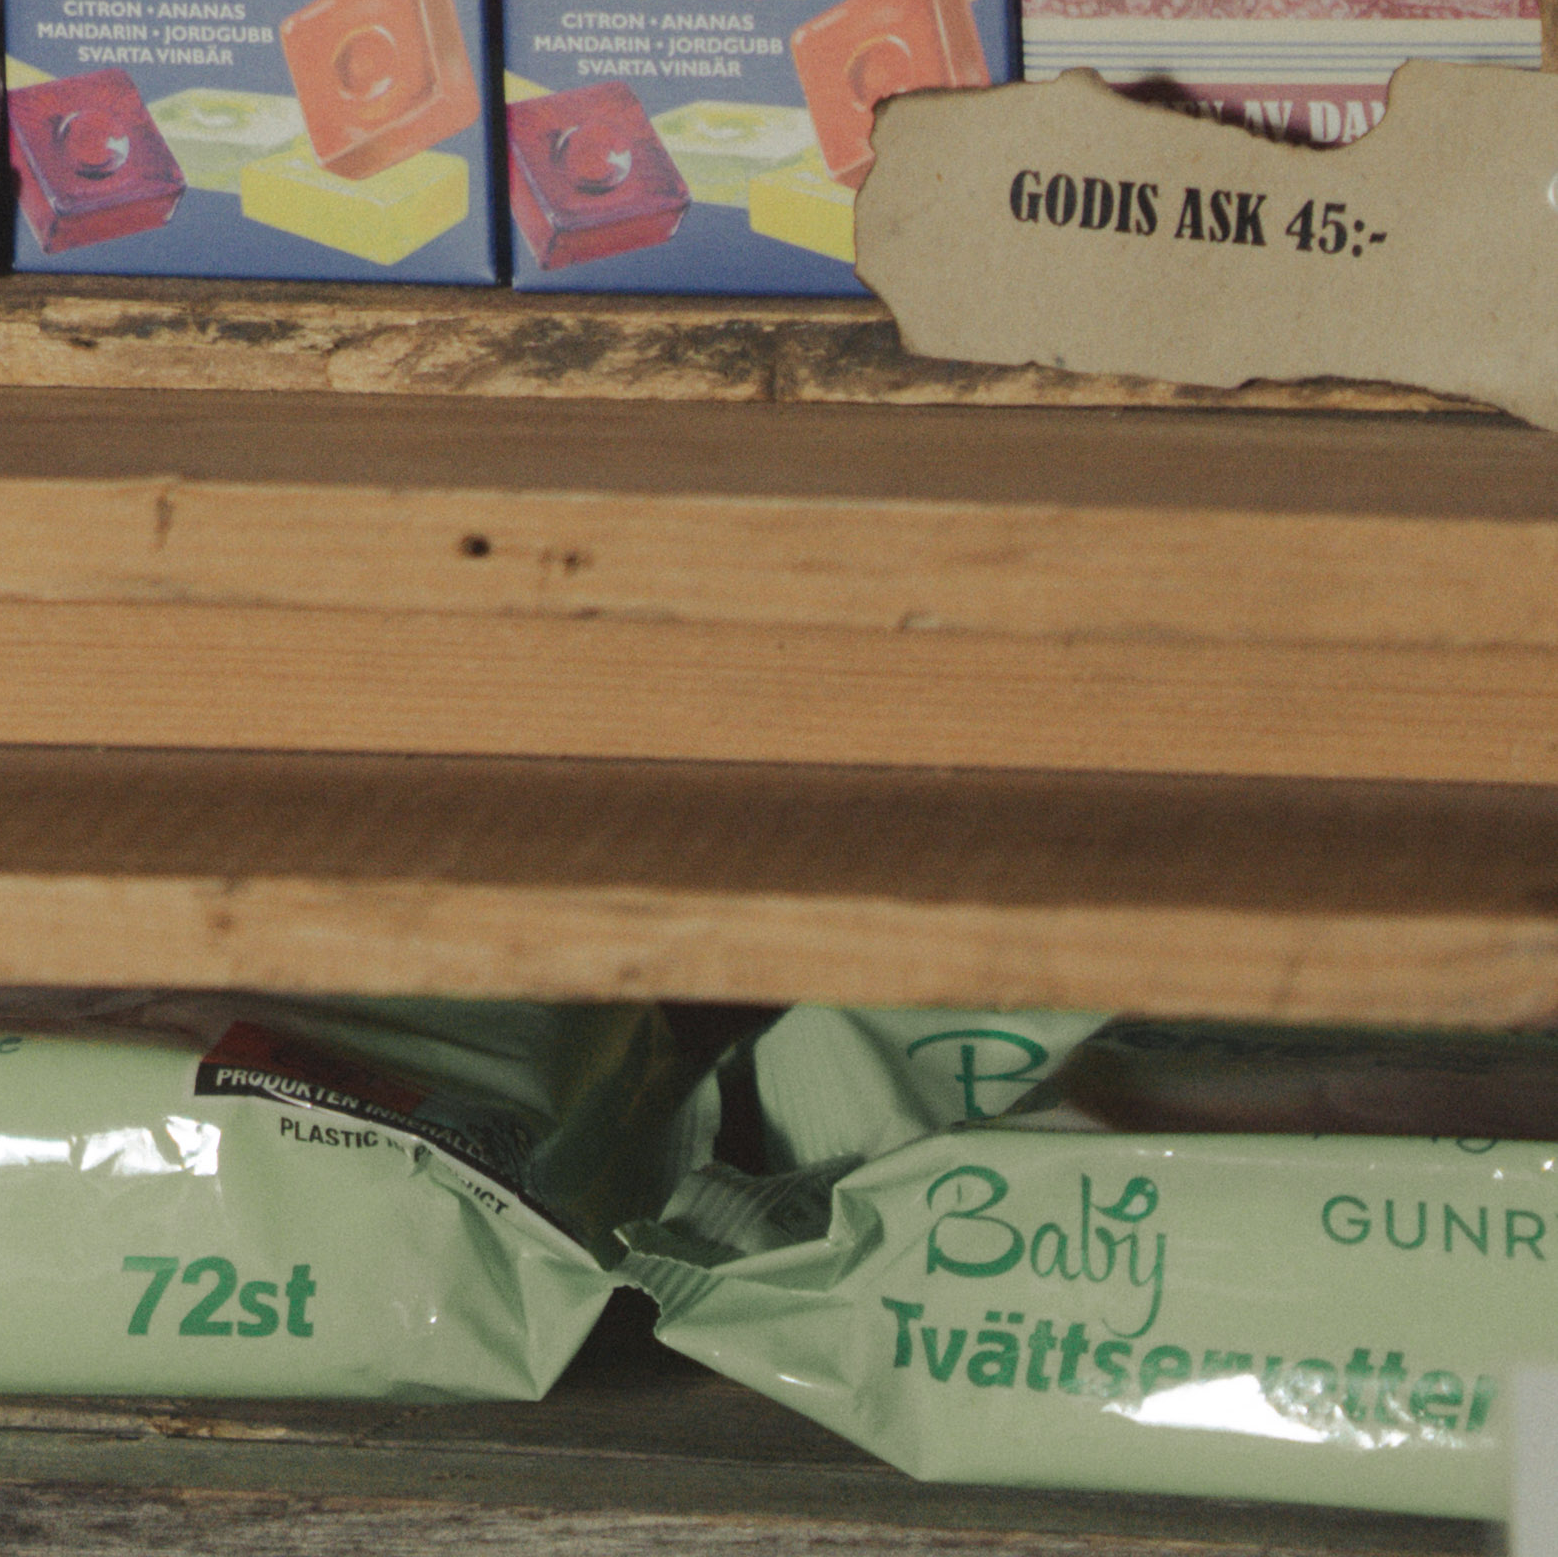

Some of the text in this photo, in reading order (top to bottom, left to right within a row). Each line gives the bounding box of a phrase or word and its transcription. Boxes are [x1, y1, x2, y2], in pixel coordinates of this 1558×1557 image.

[62, 0, 247, 20] CITRON ANANAS
[560, 12, 755, 32] CITRON ANANAS
[36, 22, 274, 45] MANDARIN JORDGUBB
[533, 34, 784, 57] MANDARIN JORDGUBB
[77, 43, 234, 66] SVARTA VINBÄR
[577, 55, 741, 79] SVARTA VINBÄR
[1009, 168, 1389, 258] GODIS ASK 45:-
[215, 1067, 363, 1111] PRODUKTEN
[279, 1116, 379, 1149] PLASTIC
[1321, 1193, 1558, 1261] GUNR
[925, 1164, 1170, 1339] Baby
[122, 1255, 318, 1339] 72st
